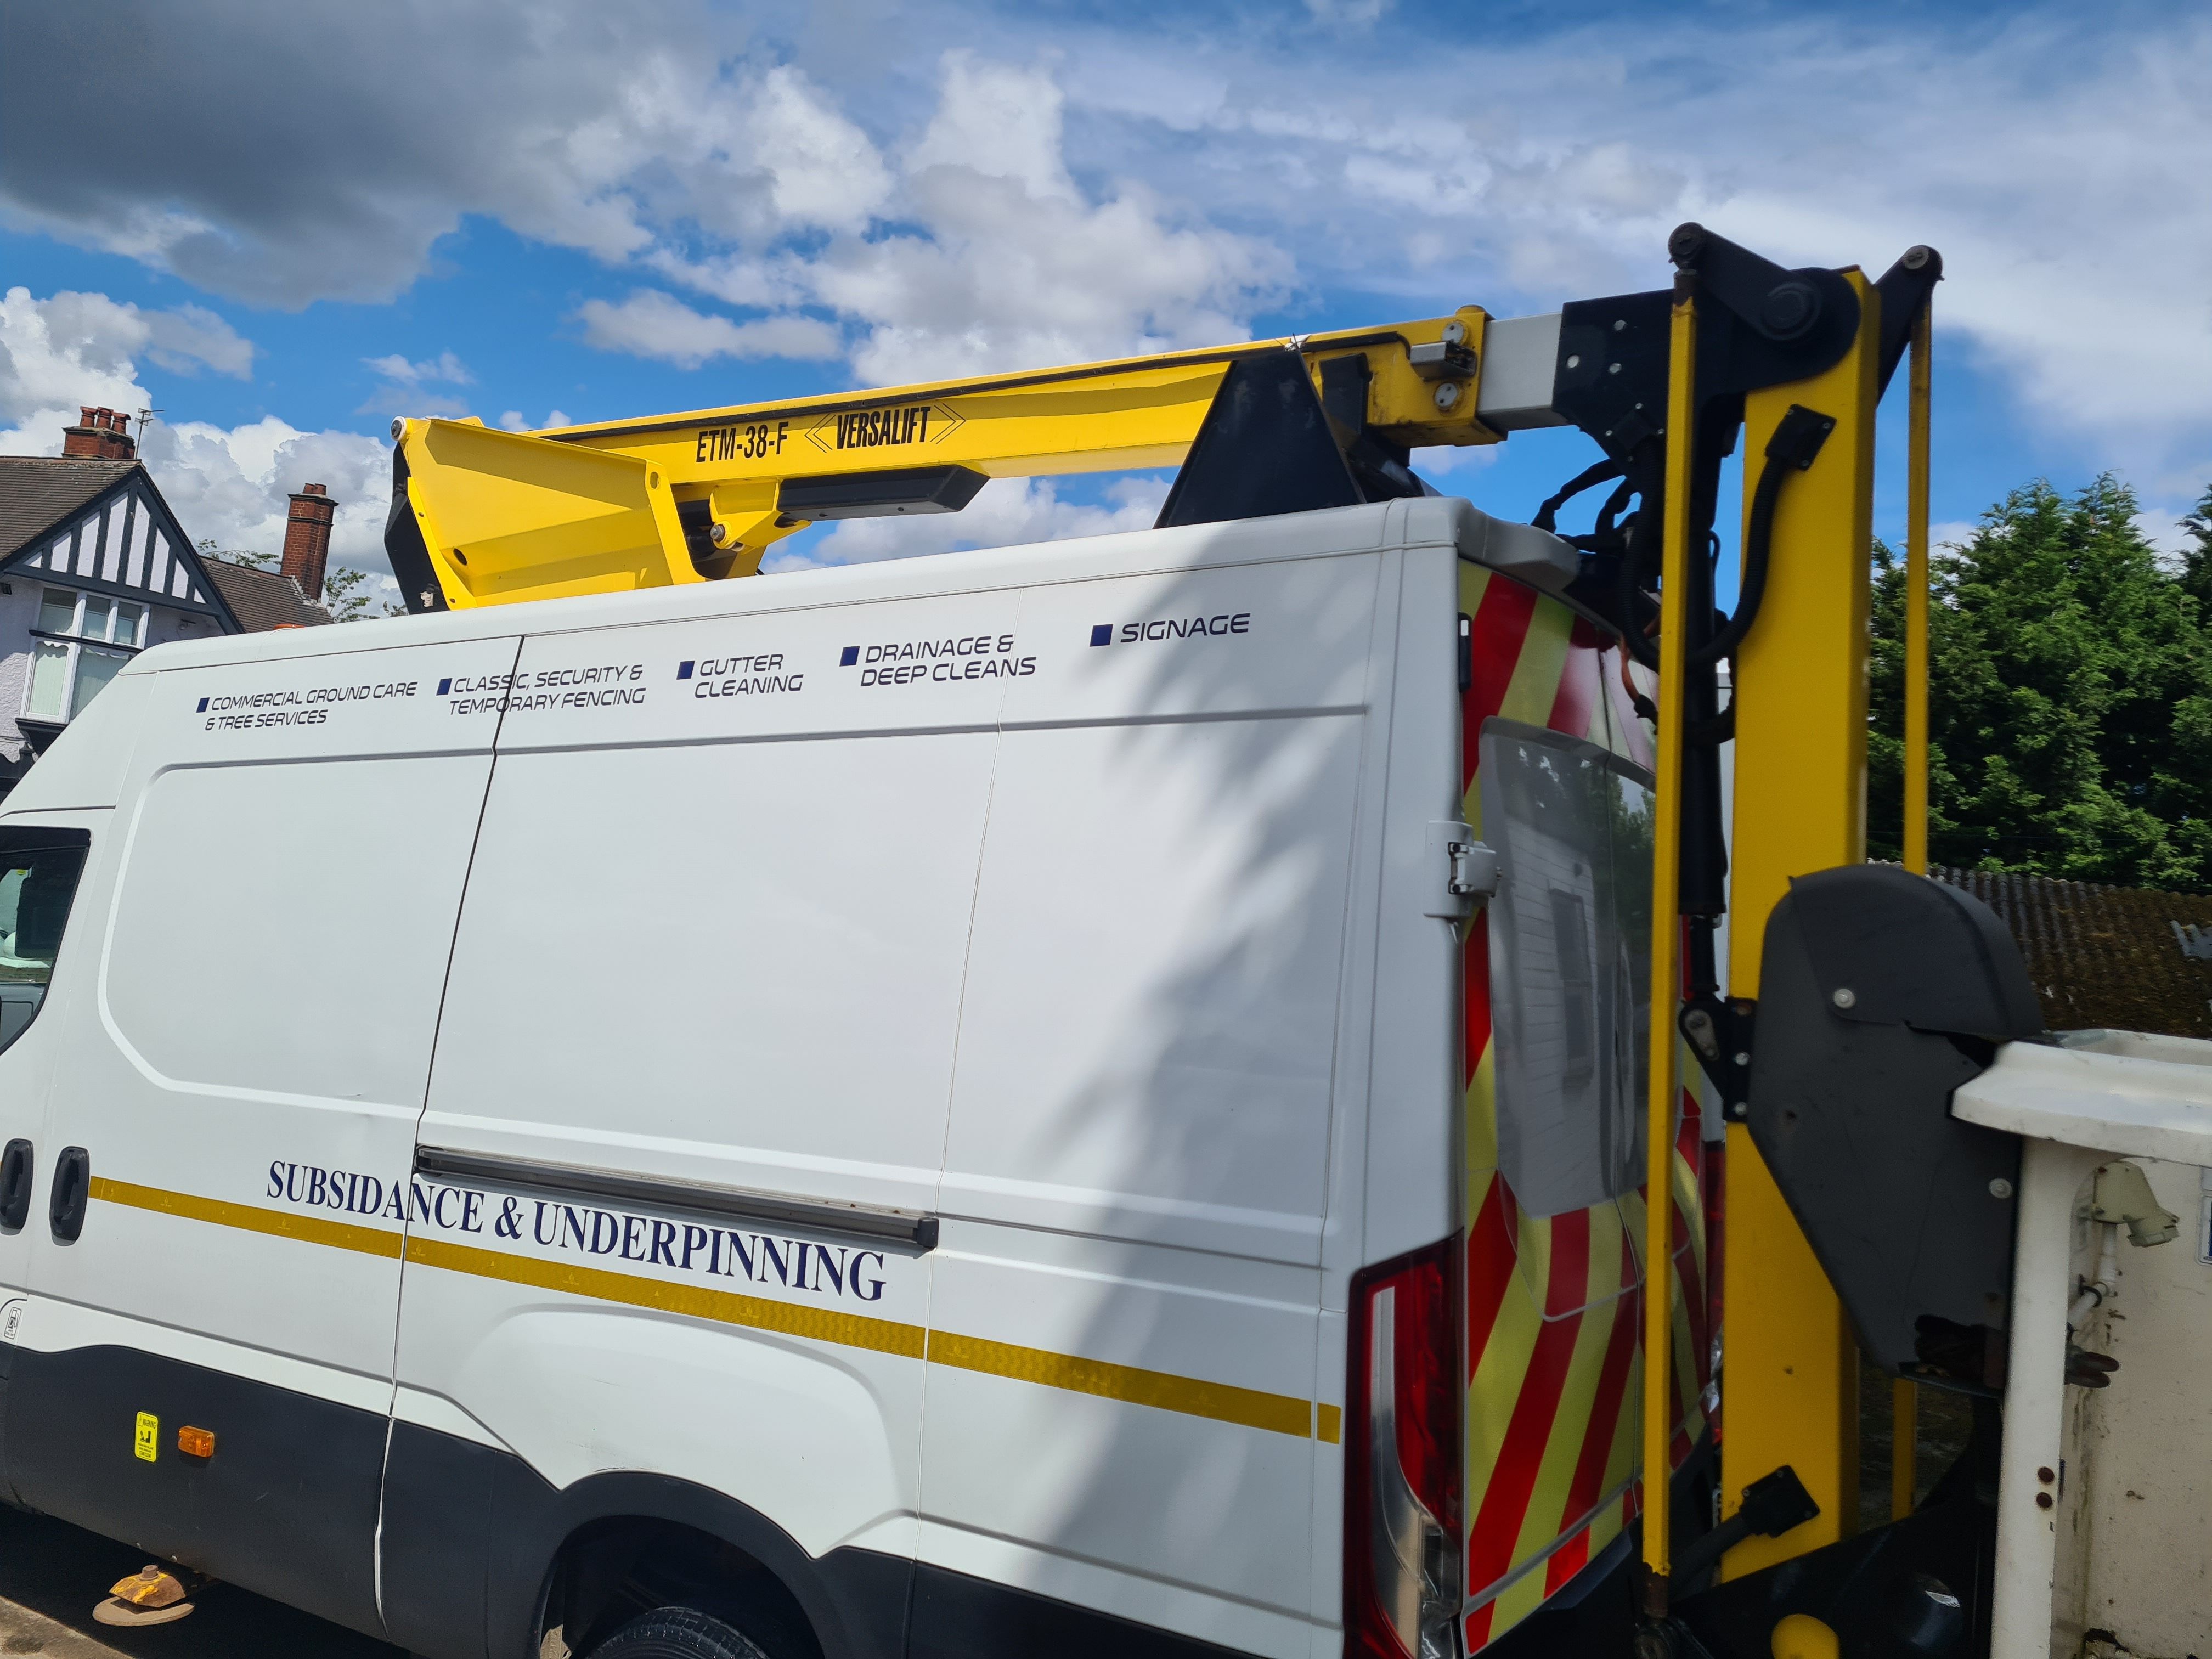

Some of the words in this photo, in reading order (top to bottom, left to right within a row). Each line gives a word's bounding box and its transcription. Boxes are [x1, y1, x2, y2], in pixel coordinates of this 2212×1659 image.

[696, 421, 789, 462] ETM-38-F
[837, 407, 931, 449] VERSALIFT
[1120, 613, 1251, 643] SIGNAGE
[865, 635, 991, 663] DRAINAGE
[996, 634, 1013, 653] &
[699, 653, 783, 675] GUTTER
[860, 664, 927, 687] DEEP
[932, 656, 1036, 682] CLEANS
[454, 674, 531, 692] CLASSIC,
[534, 666, 628, 687] SECURITY
[630, 665, 643, 680] &
[694, 675, 803, 698] CLEANING
[211, 691, 302, 710] COMMERCIAL
[306, 685, 370, 704] GROUND
[373, 682, 418, 698] CARE
[449, 694, 560, 715] TEMPORARY
[561, 688, 646, 709] FENCING
[205, 716, 216, 730] &
[217, 714, 253, 730] TREE
[254, 709, 328, 727] SERVICES
[267, 1160, 484, 1233] SUBSIDANCE
[494, 1196, 523, 1240] &
[533, 1201, 887, 1301] UNDERPINNING
